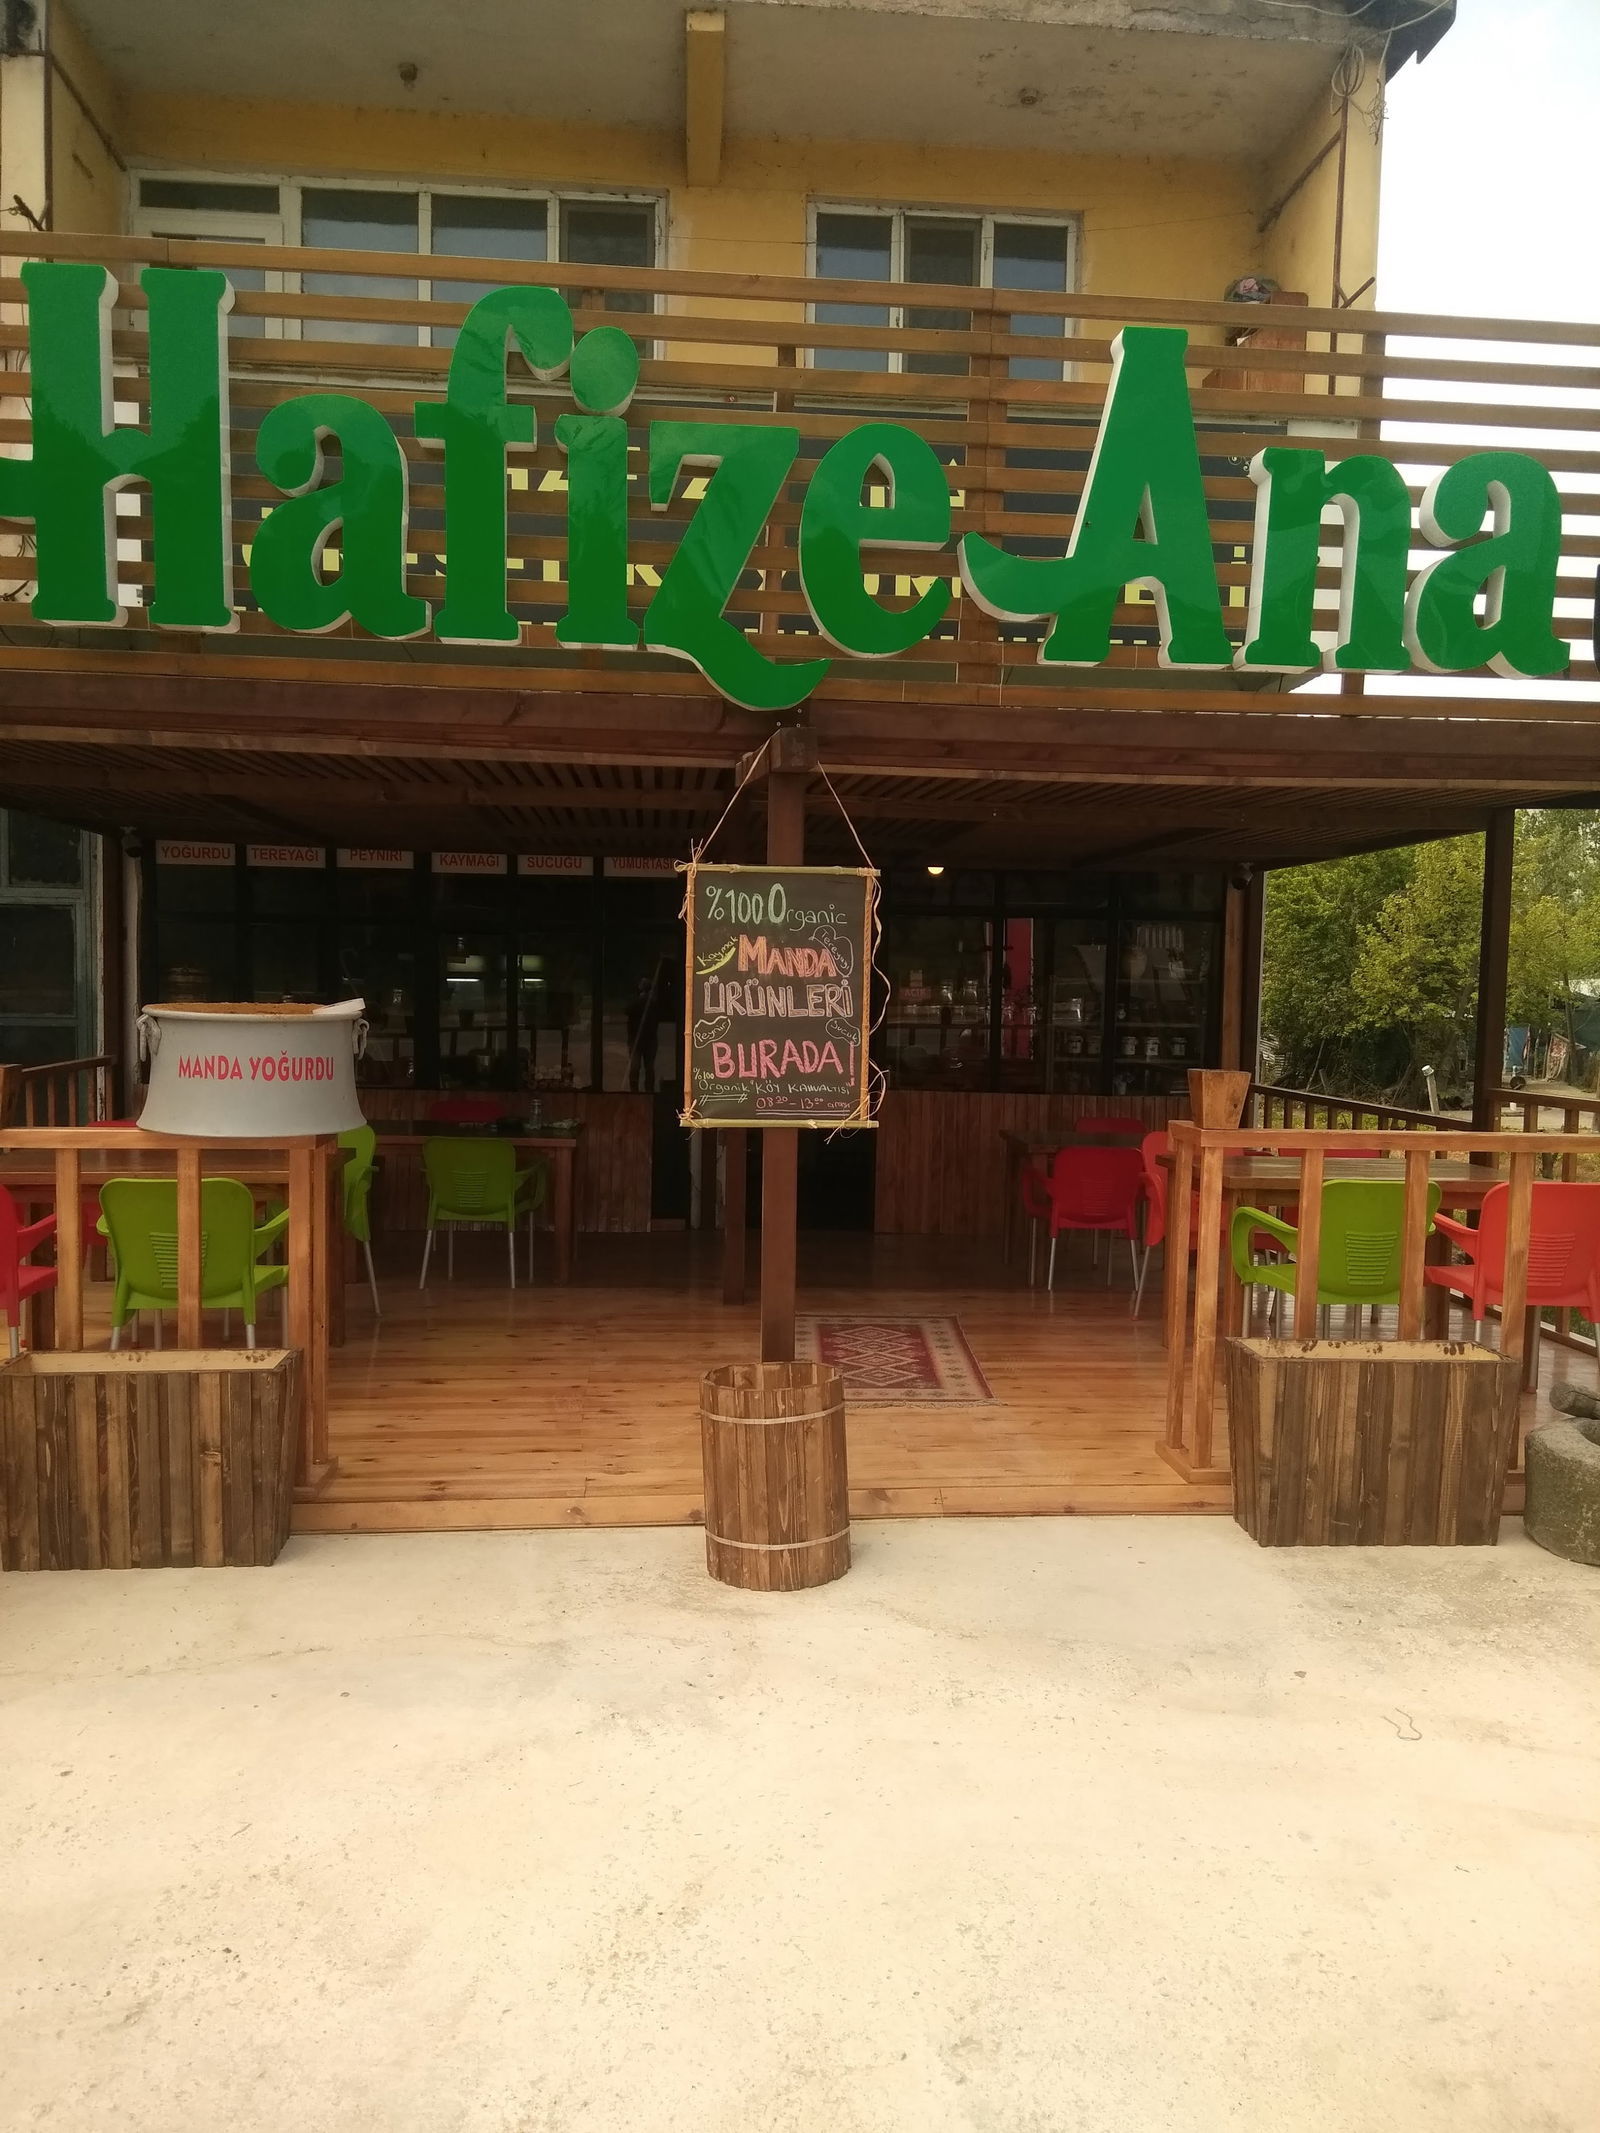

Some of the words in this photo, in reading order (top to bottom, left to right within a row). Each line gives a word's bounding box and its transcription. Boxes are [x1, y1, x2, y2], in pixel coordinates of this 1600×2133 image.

[0, 260, 951, 713] Hafize
[956, 326, 1571, 681] Ana
[160, 844, 232, 860] YOĞURDU
[737, 934, 837, 978] MANDA
[703, 975, 854, 1018] ÜRÜNLERİ
[178, 1054, 244, 1081] MANDA
[248, 1049, 335, 1082] YOĞURDU
[698, 1079, 751, 1095] Organik
